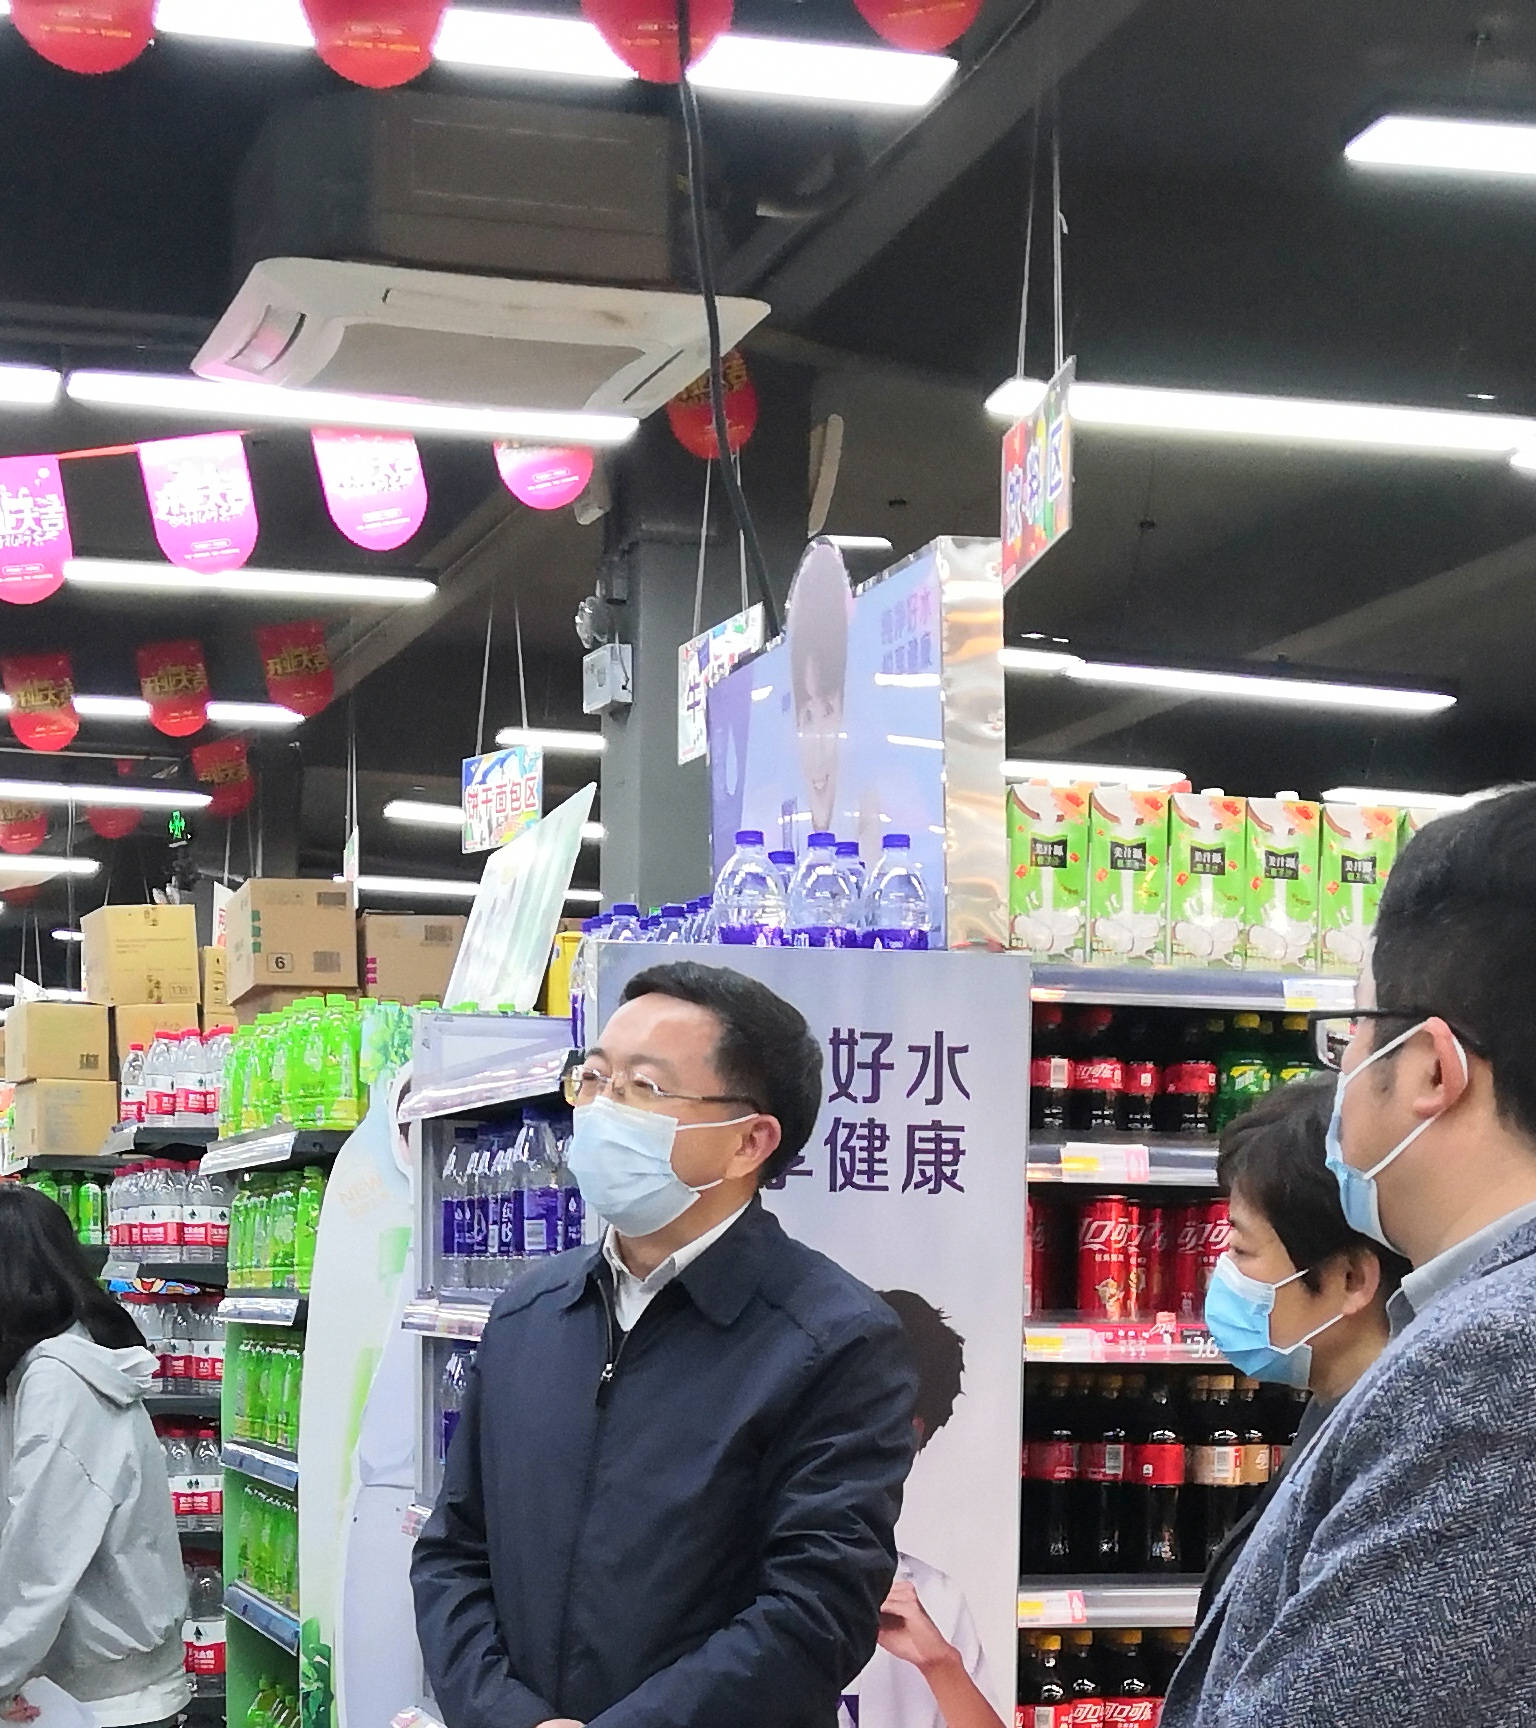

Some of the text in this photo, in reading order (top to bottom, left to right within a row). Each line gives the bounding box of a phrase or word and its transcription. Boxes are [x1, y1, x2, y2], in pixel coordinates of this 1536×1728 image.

[466, 774, 538, 823] 饼干面包区
[275, 957, 286, 970] 6
[828, 1027, 971, 1106] 好水
